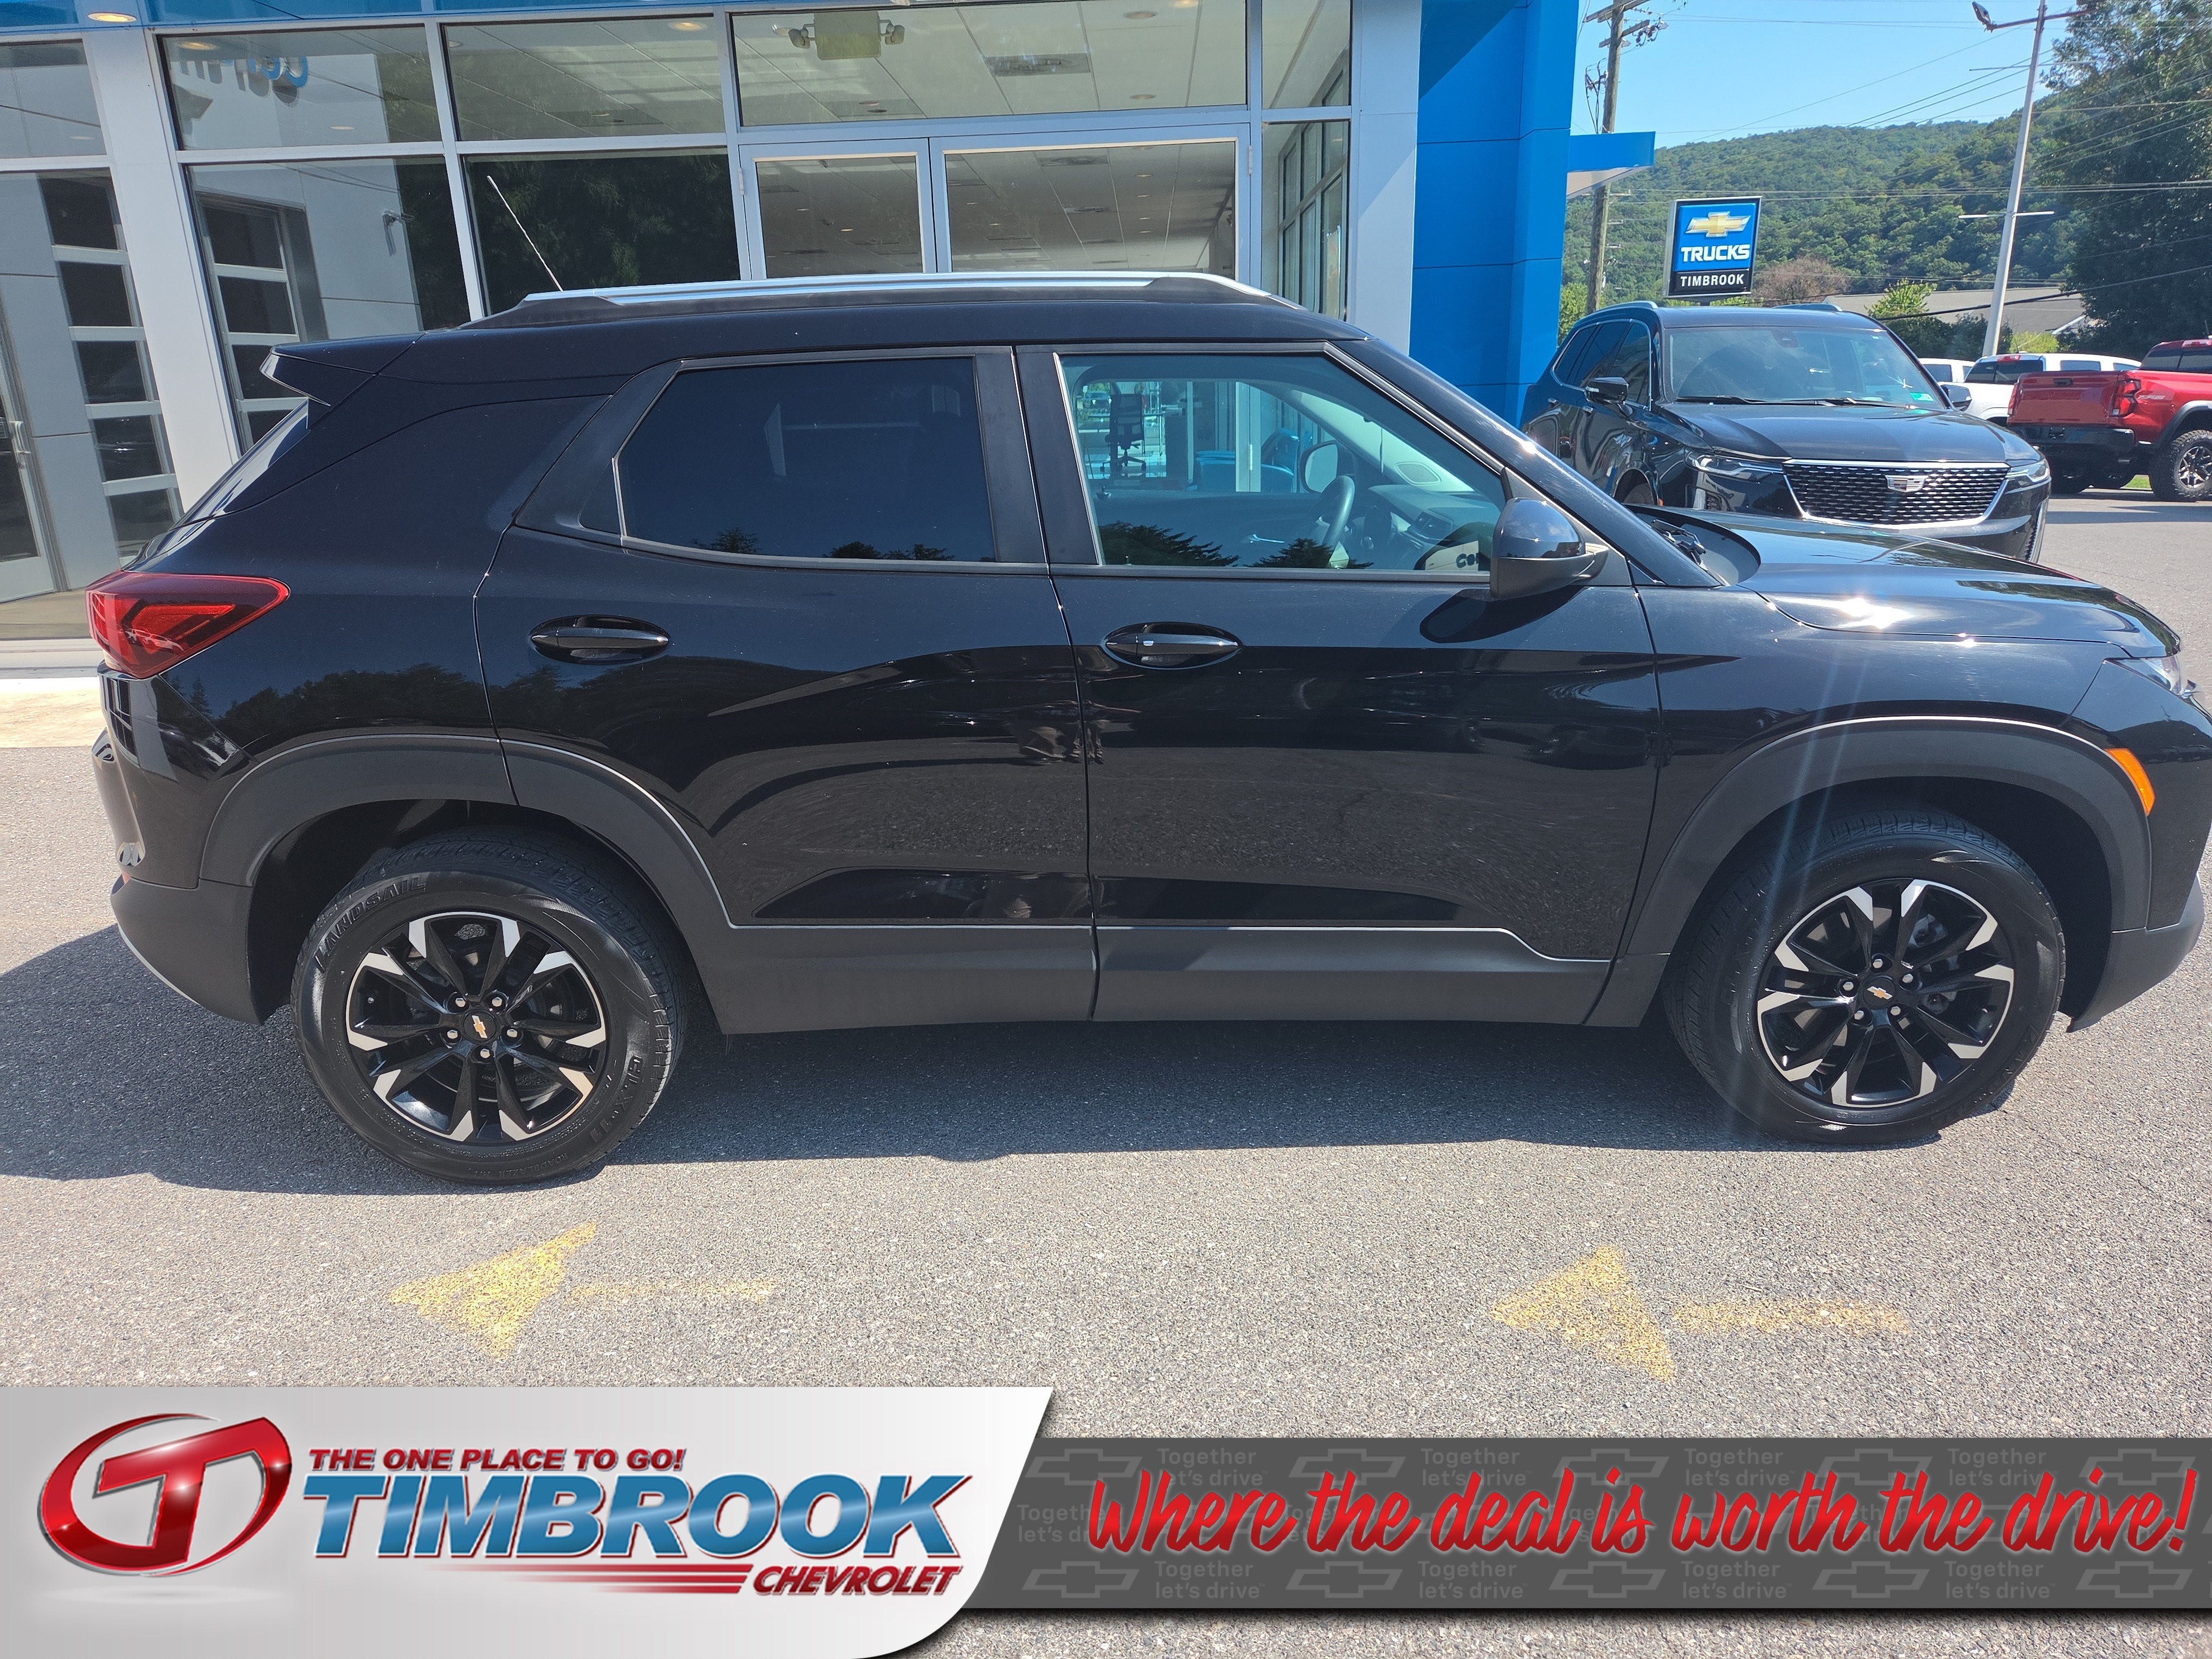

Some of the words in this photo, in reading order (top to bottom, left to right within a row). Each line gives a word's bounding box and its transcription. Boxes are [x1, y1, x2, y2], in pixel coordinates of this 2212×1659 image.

[1681, 245, 1750, 262] TRUCKS
[1680, 274, 1744, 287] TIMBROOK
[313, 876, 427, 973] LANDSAIL
